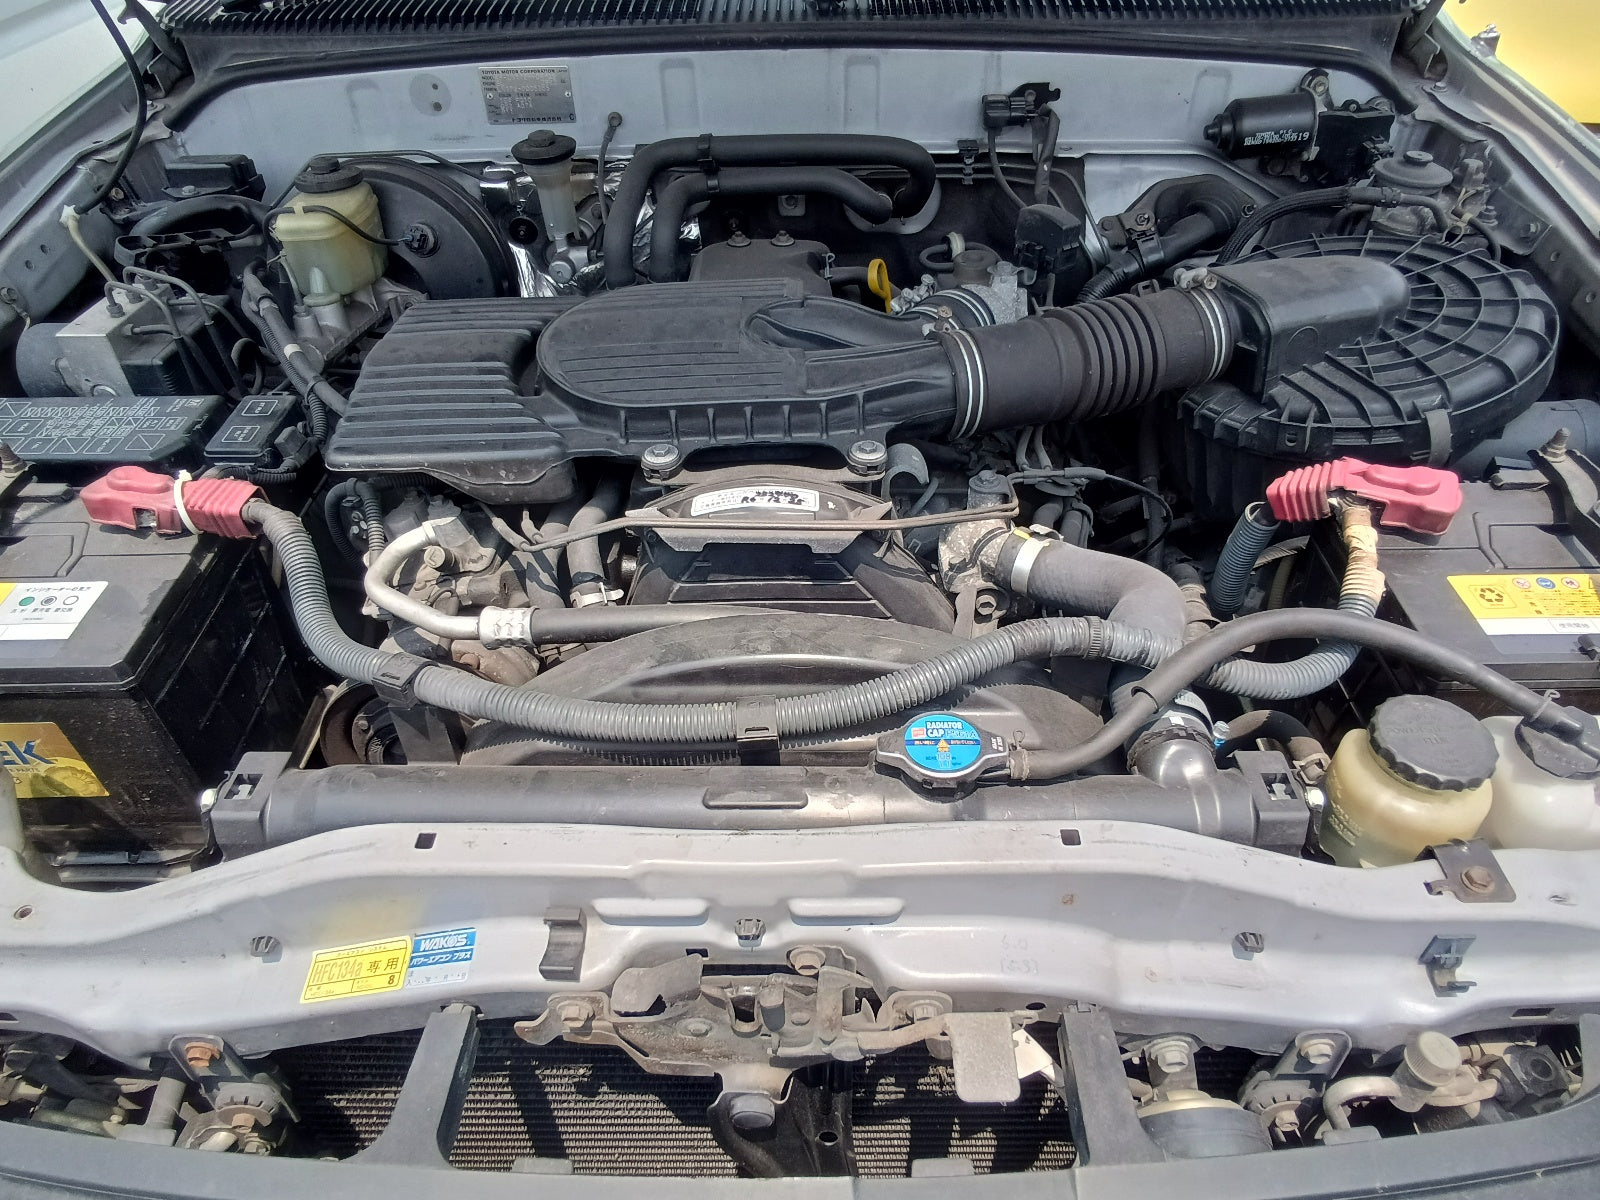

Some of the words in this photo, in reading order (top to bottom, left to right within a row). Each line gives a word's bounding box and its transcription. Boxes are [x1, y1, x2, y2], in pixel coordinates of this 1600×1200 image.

[926, 721, 963, 730] RADIATOR
[927, 728, 945, 738] CAP
[311, 957, 364, 984] HFC134a
[366, 956, 400, 974] 専用
[387, 974, 396, 985] 8
